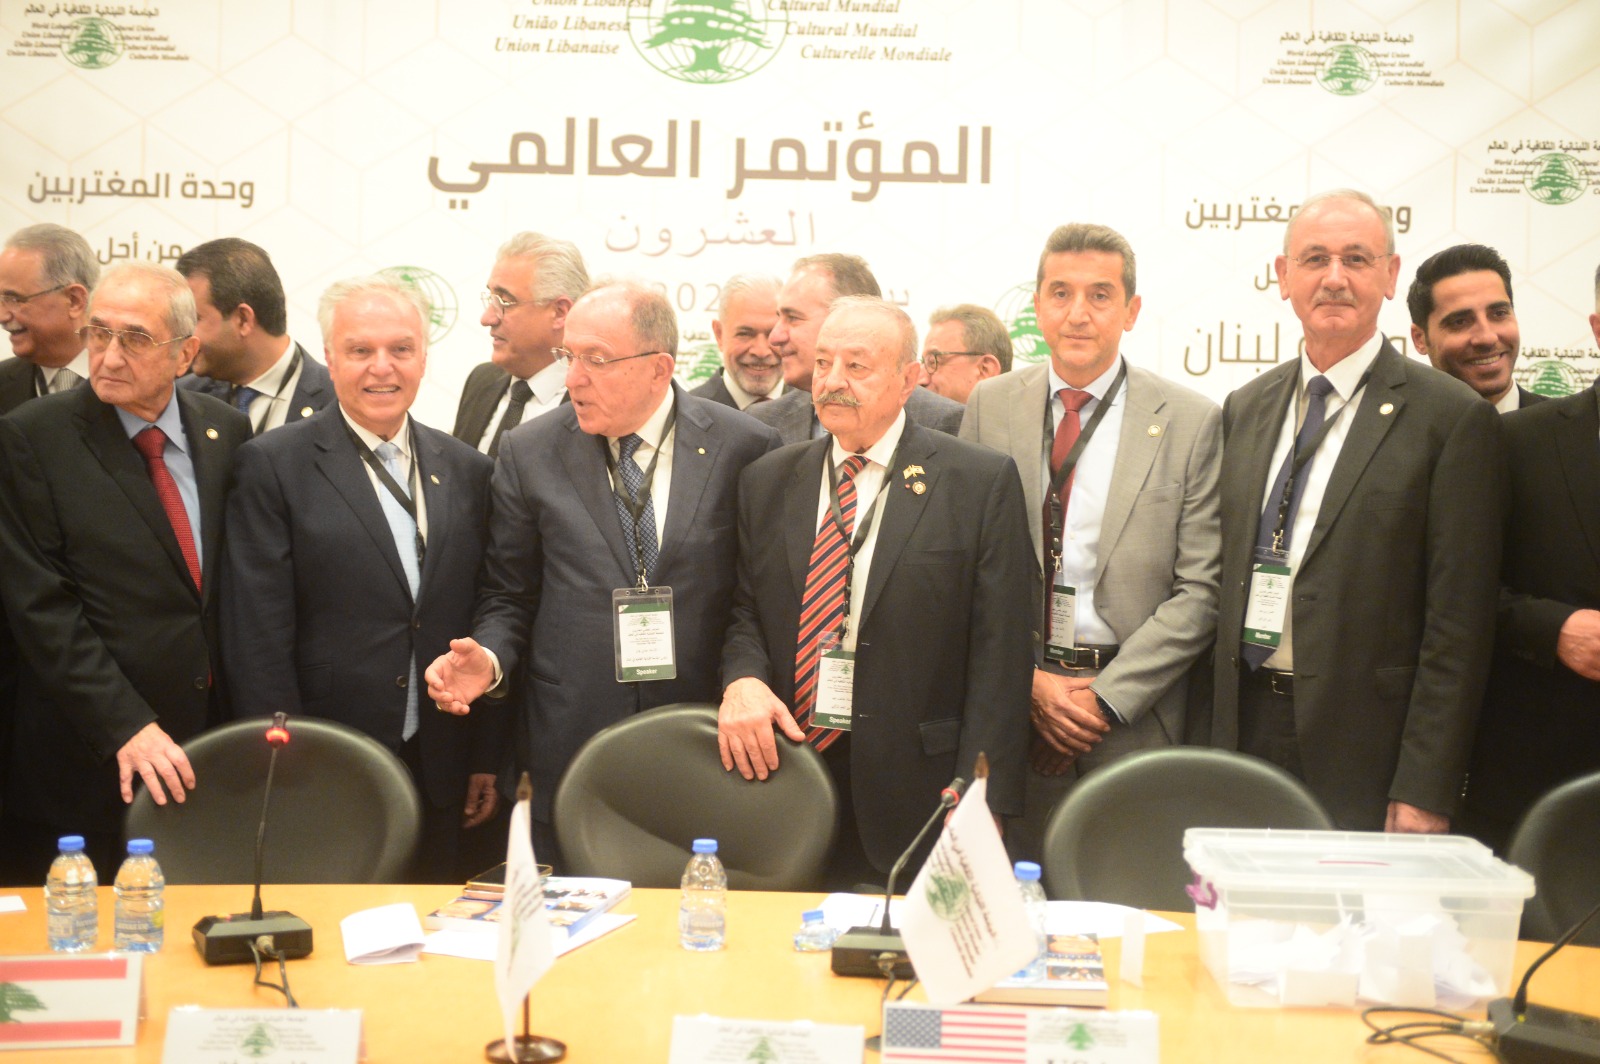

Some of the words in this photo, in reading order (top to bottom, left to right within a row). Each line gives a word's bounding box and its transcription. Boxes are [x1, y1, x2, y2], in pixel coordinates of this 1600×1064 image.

[24, 4, 45, 16] العالم
[49, 4, 60, 18] في
[63, 4, 91, 17] الثقافية
[95, 4, 125, 17] اللبنانية
[129, 7, 159, 17] الجامعة
[768, 0, 831, 12] Cultural
[834, 0, 900, 14] Mundial
[512, 15, 558, 32] União
[563, 15, 631, 32] Libanesa
[786, 21, 849, 37] Cultural
[854, 22, 918, 39] Mundial
[1280, 31, 1300, 43] العالم
[1304, 30, 1315, 45] في
[1318, 30, 1347, 44] الثقافية
[1350, 32, 1380, 45] اللبنانية
[1384, 32, 1414, 43] الجامعة
[494, 38, 541, 53] Union
[546, 38, 620, 56] Libanaise
[800, 44, 876, 61] Culturelle
[881, 46, 952, 62] Mondiale
[1488, 140, 1508, 153] العالم
[1512, 139, 1523, 154] في
[1526, 140, 1555, 153] الثقافية
[427, 116, 700, 210] العالمي
[726, 110, 992, 203] المؤتمر
[27, 170, 170, 204] المغتربين
[181, 173, 255, 209] وحدة
[604, 210, 818, 257] العشرون
[1184, 321, 1280, 376] لبنان
[636, 668, 658, 676] Speaker
